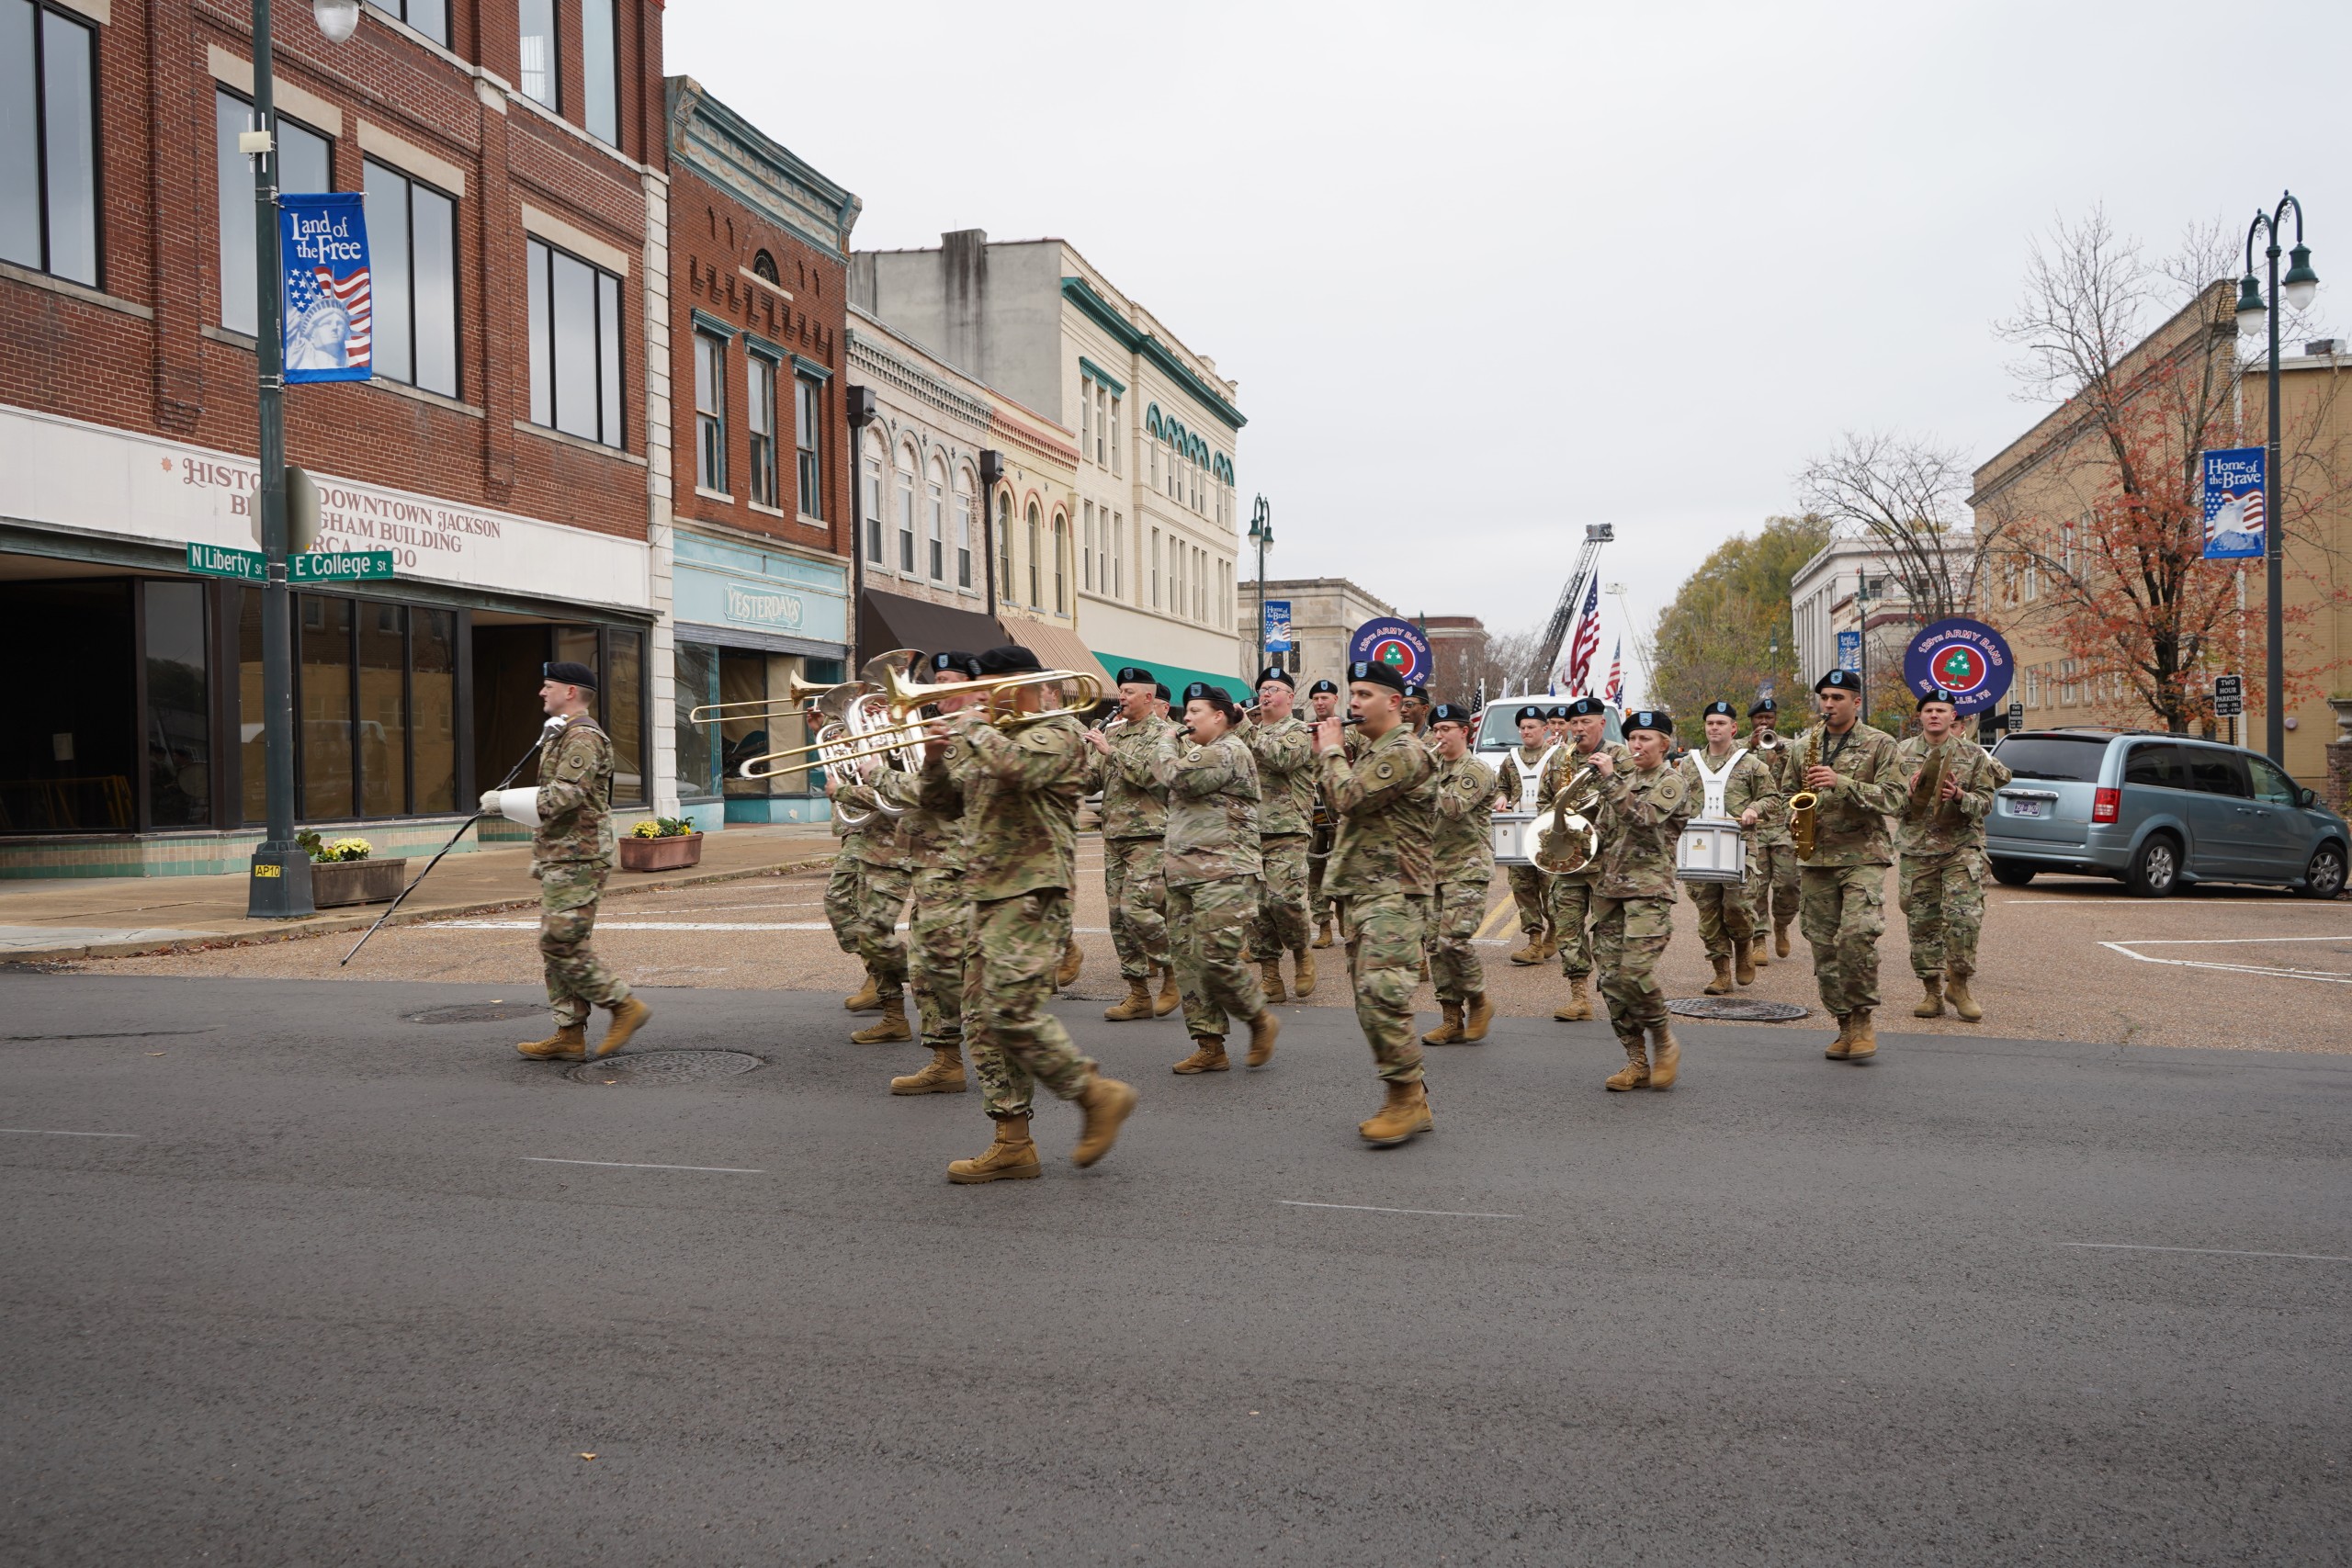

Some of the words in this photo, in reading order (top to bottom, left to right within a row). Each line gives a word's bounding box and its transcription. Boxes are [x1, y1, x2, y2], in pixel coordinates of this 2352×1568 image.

[290, 209, 332, 241] Land
[333, 216, 350, 237] of
[296, 241, 319, 258] the
[316, 235, 362, 265] Free
[2208, 458, 2245, 475] Home
[2245, 460, 2258, 473] of
[2210, 474, 2222, 485] the
[2222, 471, 2262, 489] Brave
[319, 487, 433, 525] DOWNTOWN
[437, 511, 501, 538] JACKSON
[379, 522, 462, 552] BUILDING
[192, 545, 201, 568] N
[205, 546, 251, 578] Liberty
[254, 563, 262, 575] St
[295, 556, 306, 576] E
[311, 554, 371, 580] College
[377, 560, 387, 571] St
[728, 588, 801, 623] YESTERDAYS
[1267, 605, 1283, 614] Home
[1273, 612, 1290, 620] Brave
[1376, 626, 1405, 637] ARMY
[1404, 631, 1426, 653] BAND
[1945, 629, 1982, 641] ARMY
[1979, 637, 2003, 666] BAND
[1976, 689, 1992, 701] TN
[255, 866, 280, 876] AP10
